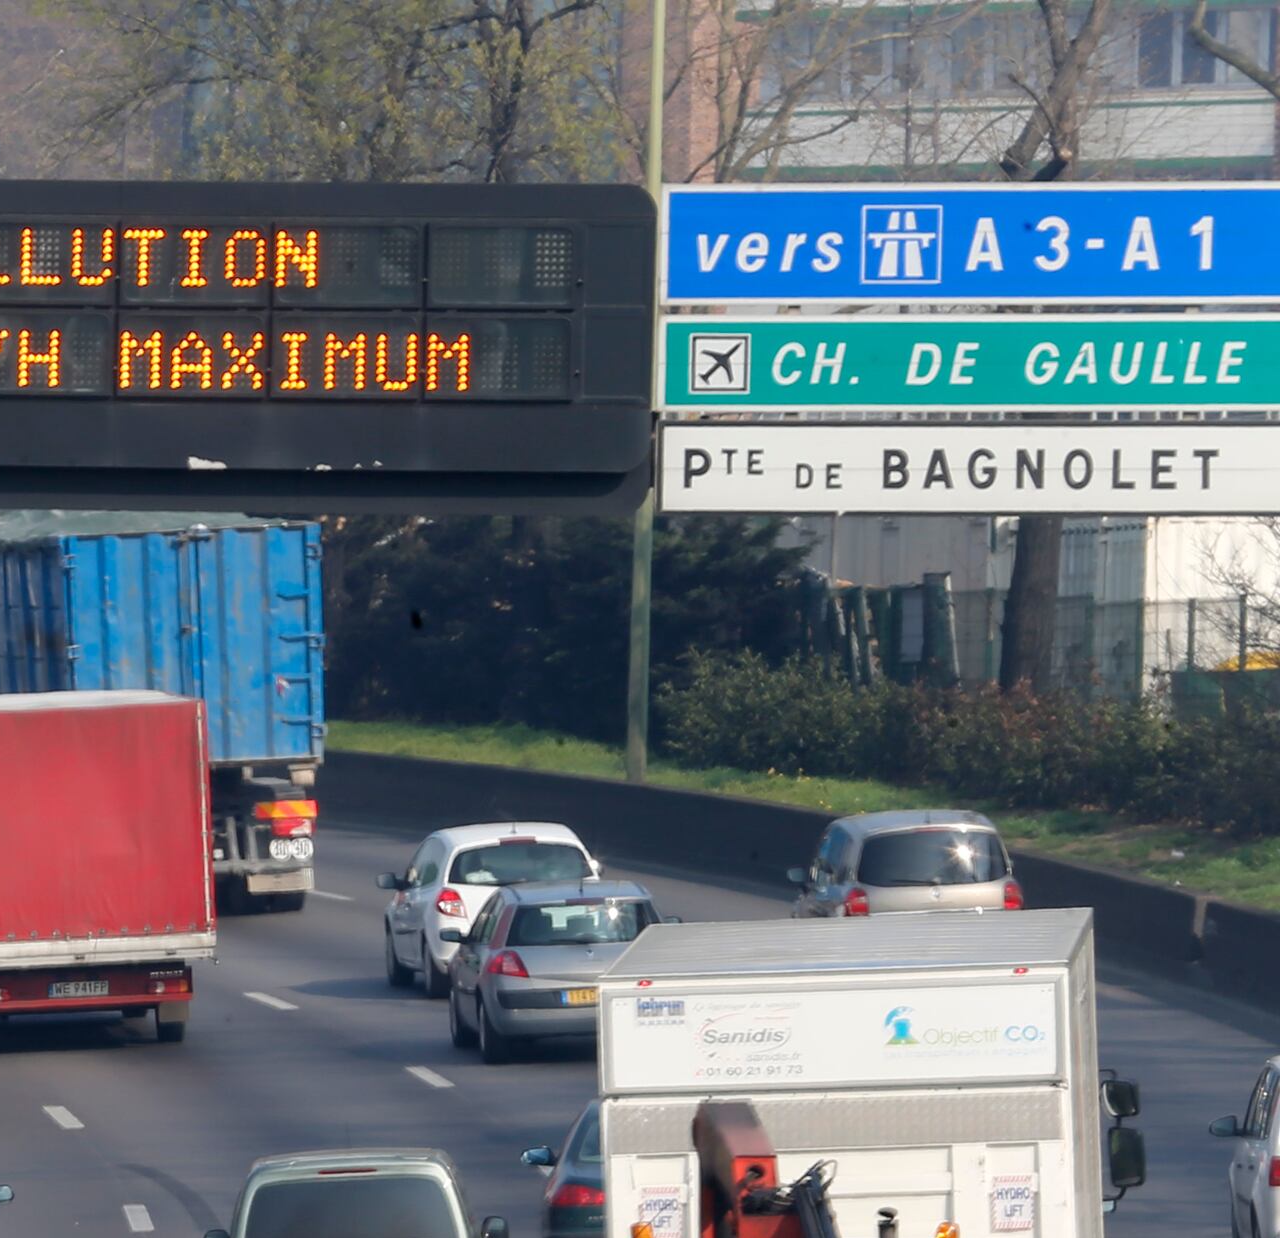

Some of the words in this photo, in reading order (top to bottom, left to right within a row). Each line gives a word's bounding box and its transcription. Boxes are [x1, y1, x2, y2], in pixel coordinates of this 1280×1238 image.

[696, 231, 844, 273] vers
[119, 330, 471, 391] MAXIMUM
[771, 341, 860, 385] CH.
[905, 342, 980, 385] DE
[1023, 340, 1247, 385] GAULLE
[881, 447, 1220, 490] BAGNOLET
[702, 1029, 786, 1044] Sanidis
[922, 1021, 1000, 1046] Objectif
[706, 1067, 721, 1077] 01
[726, 1067, 741, 1077] 60
[746, 1066, 761, 1076] 21
[766, 1065, 782, 1075] 91
[787, 1064, 803, 1075] 73
[996, 1187, 1030, 1200] HYDRO
